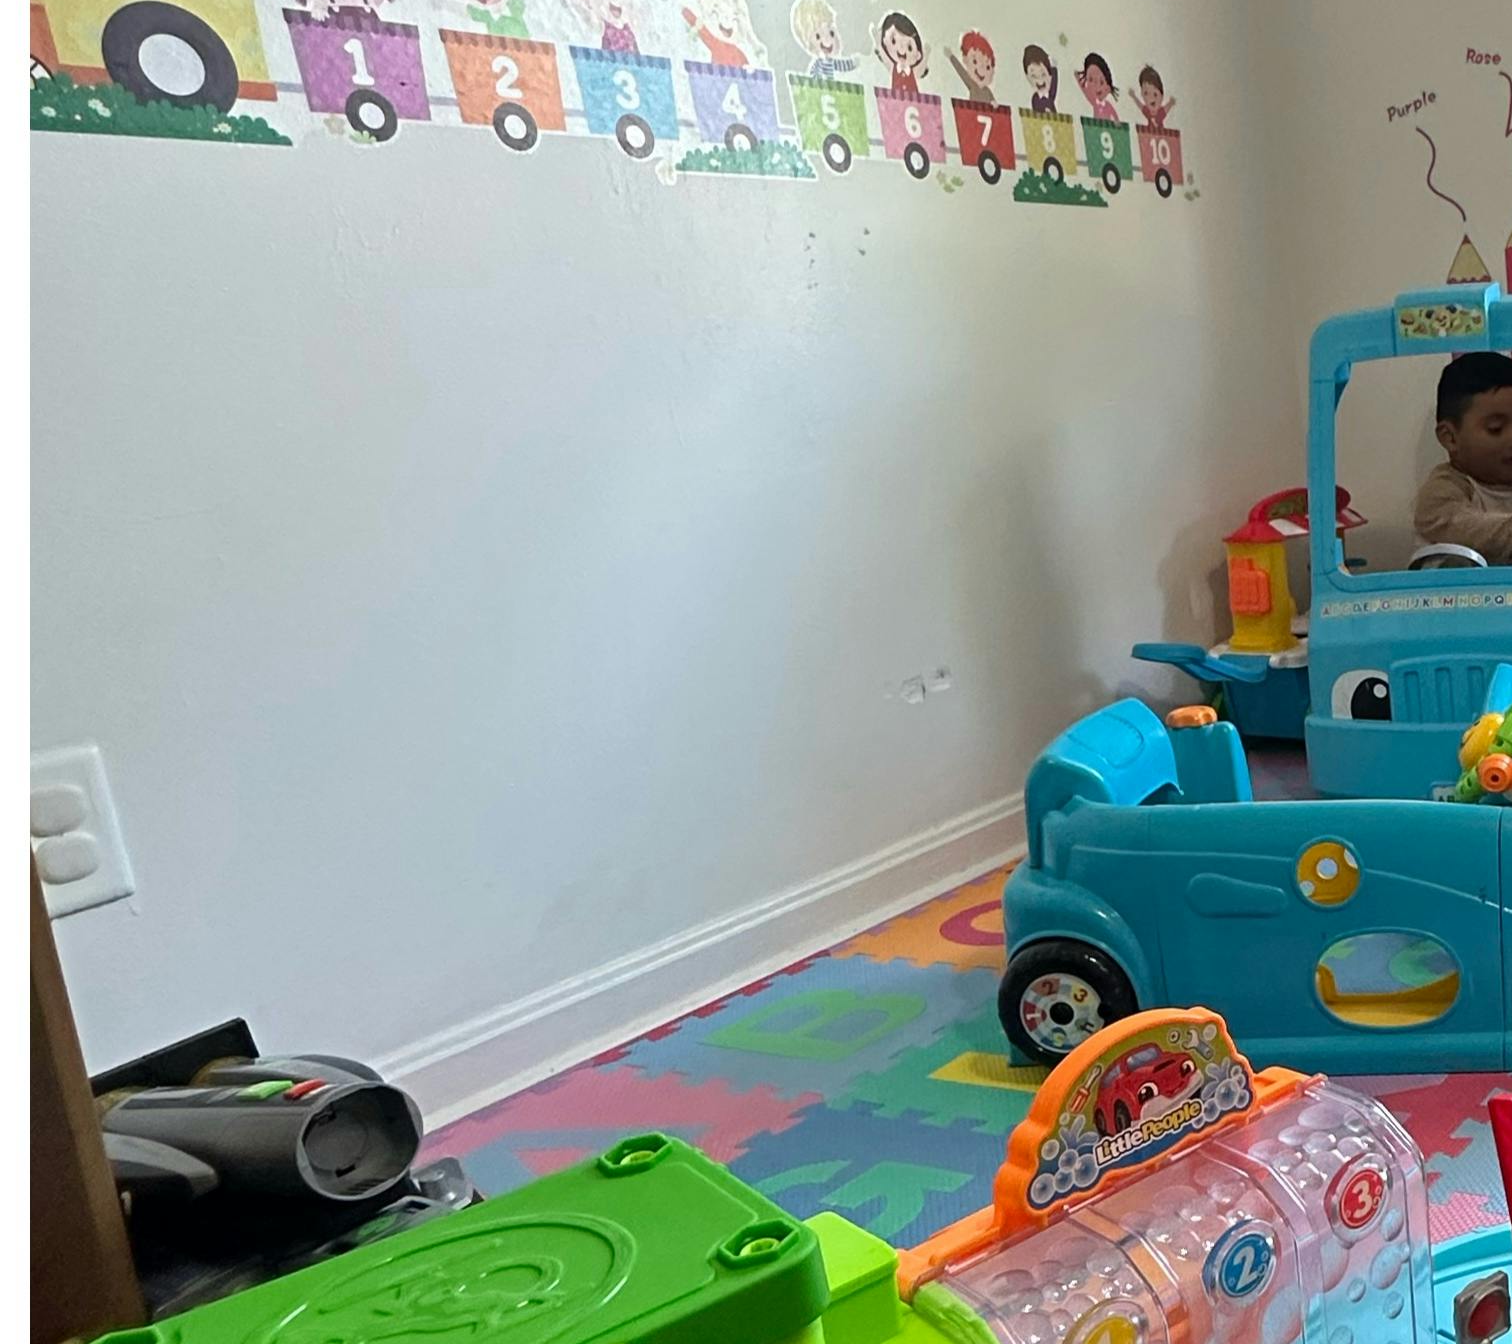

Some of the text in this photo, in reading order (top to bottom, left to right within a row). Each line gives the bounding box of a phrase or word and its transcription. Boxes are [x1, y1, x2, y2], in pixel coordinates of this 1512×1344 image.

[344, 37, 375, 86] 1
[1466, 47, 1502, 66] Rose
[491, 55, 521, 99] 2
[616, 70, 641, 111] 3
[723, 82, 747, 121] 4
[820, 94, 841, 129] 5
[1387, 90, 1437, 122] Purple
[905, 106, 922, 140] 6
[977, 115, 994, 146] 7
[1042, 124, 1055, 154] 8
[1101, 131, 1114, 159] 9
[1149, 138, 1170, 166] 10
[697, 988, 927, 1059] B
[1352, 1175, 1373, 1219] 3
[1234, 1245, 1259, 1289] 2
